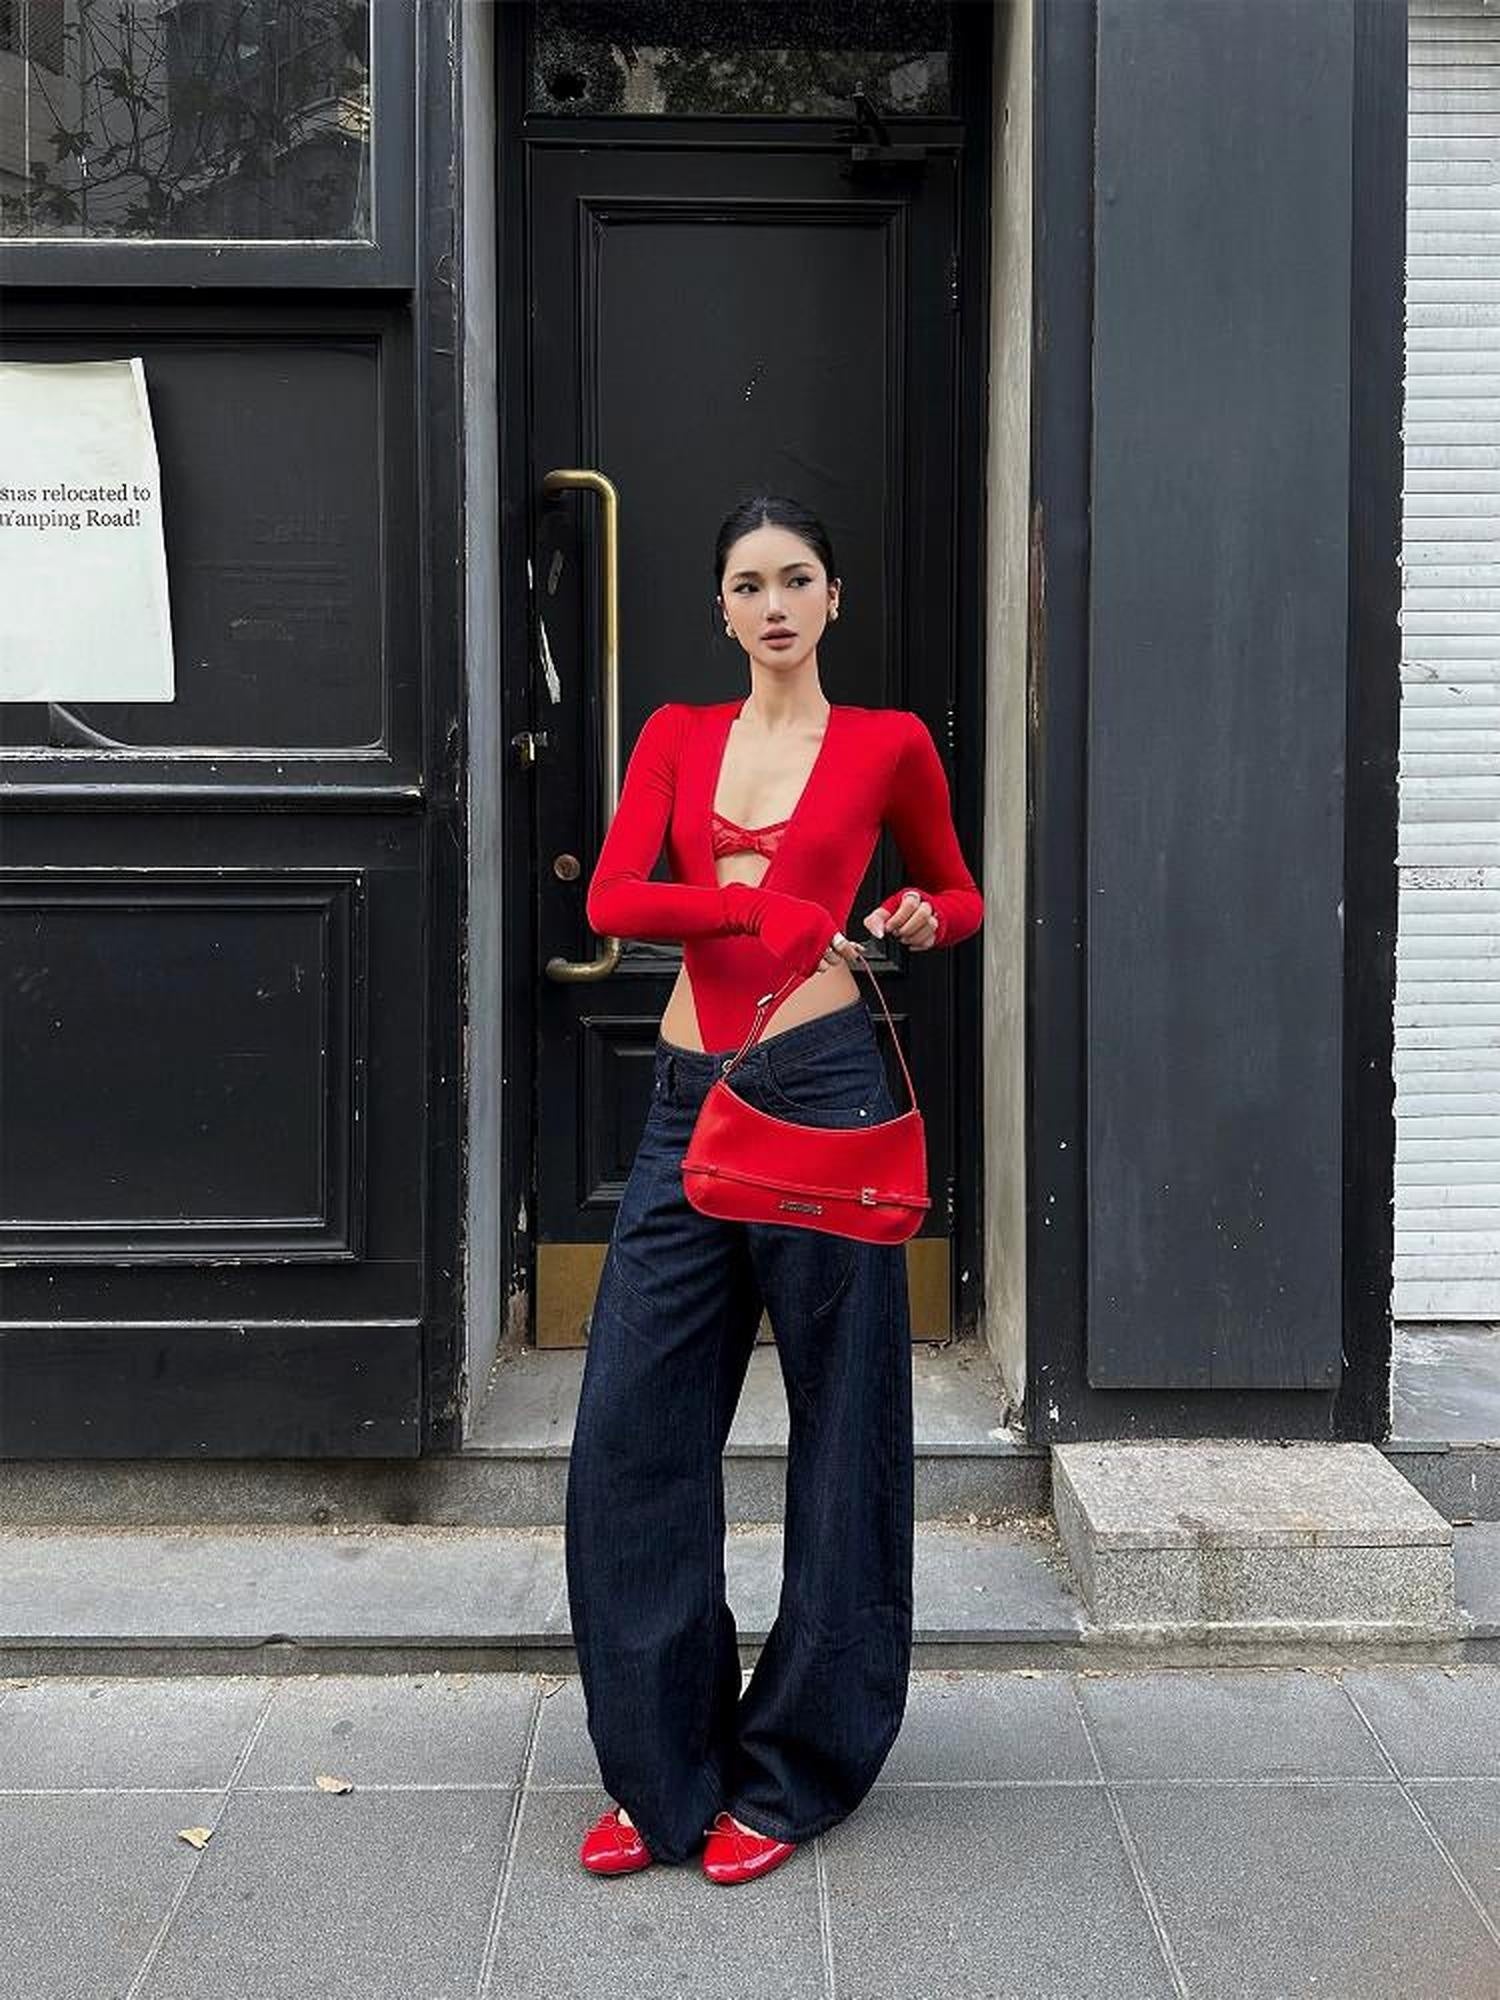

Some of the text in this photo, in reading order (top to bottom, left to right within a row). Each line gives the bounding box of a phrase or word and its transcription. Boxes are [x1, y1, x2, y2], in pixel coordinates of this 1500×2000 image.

[42, 484, 128, 502] relocated
[133, 486, 151, 502] to
[86, 508, 141, 527] Road!
